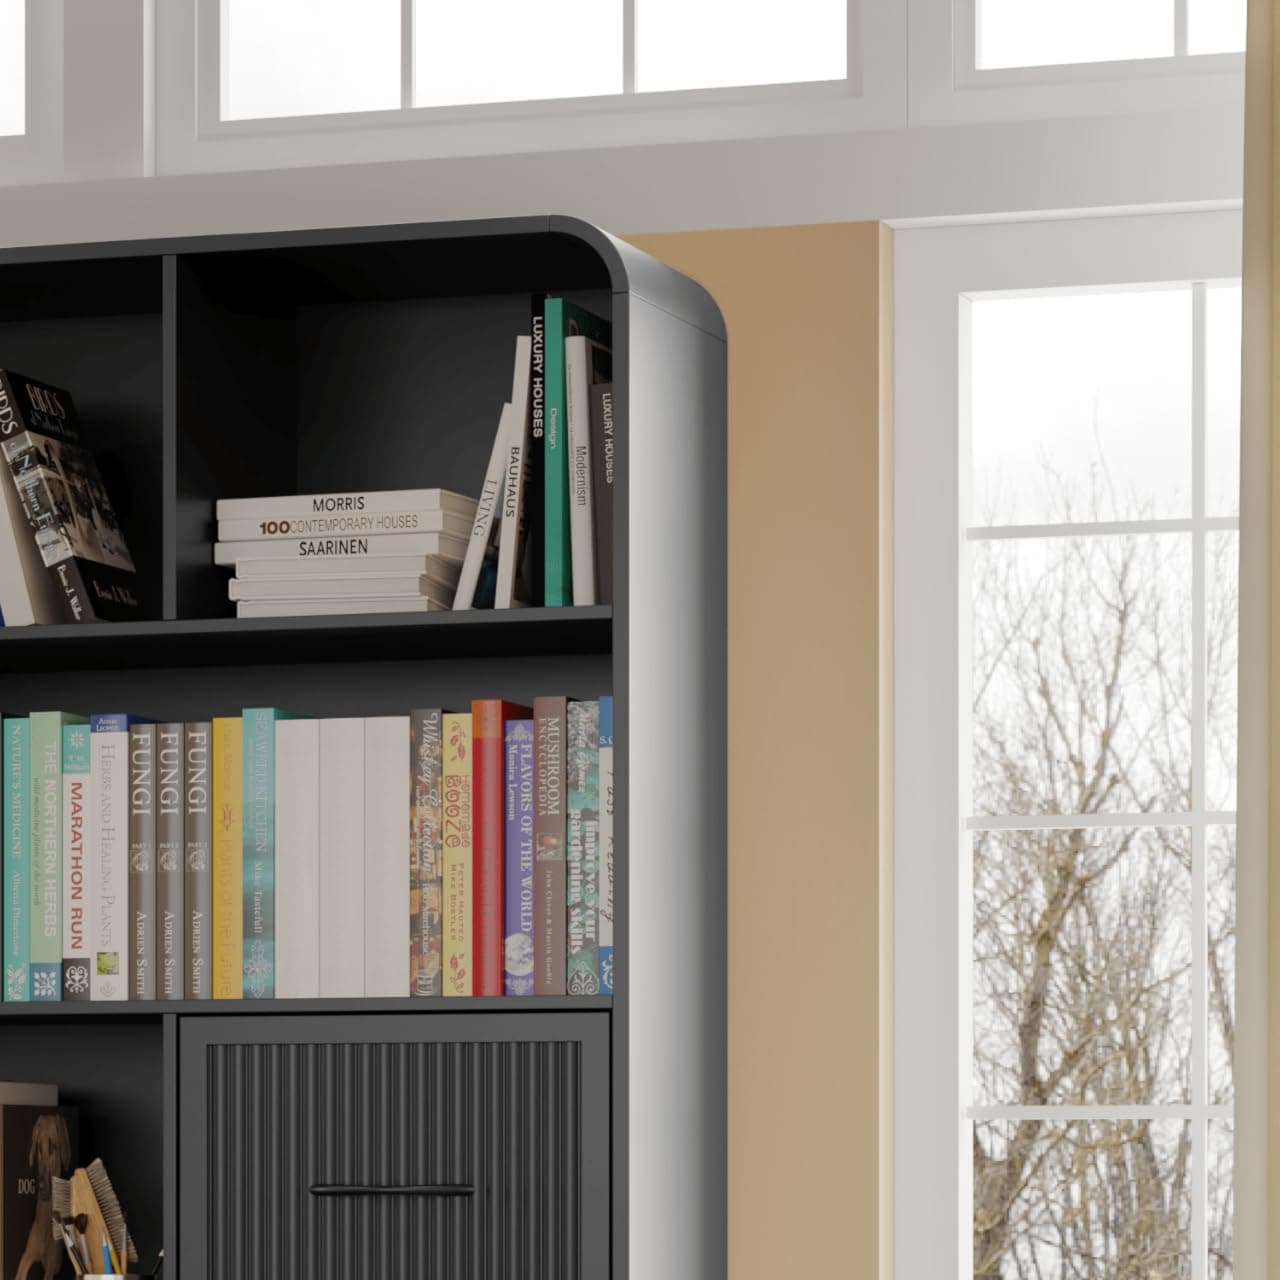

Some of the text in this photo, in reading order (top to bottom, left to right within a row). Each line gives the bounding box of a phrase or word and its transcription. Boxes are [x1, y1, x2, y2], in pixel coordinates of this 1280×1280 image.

[533, 317, 543, 438] LUXURY HOUSES
[548, 408, 558, 449] Design
[313, 497, 365, 512] MORRIS
[473, 479, 498, 537] LIVING
[505, 447, 520, 518] BAUHAUS
[575, 446, 588, 506] Modernism
[299, 539, 368, 556] SAARINEN
[376, 515, 418, 530] HOUSES
[132, 732, 151, 815] FUNGI
[160, 731, 179, 815] FUNGI
[188, 731, 207, 815] FUNGI
[538, 718, 547, 816] ENCYCLOPEDIA
[547, 718, 560, 815] MUSHROOM
[44, 740, 57, 937] THE NORTHERN HERBS
[71, 782, 83, 900] MARATHON
[520, 744, 532, 932] FLAVORS OF THE WORLD
[71, 908, 83, 949] RUN
[18, 1179, 35, 1194] DOG
